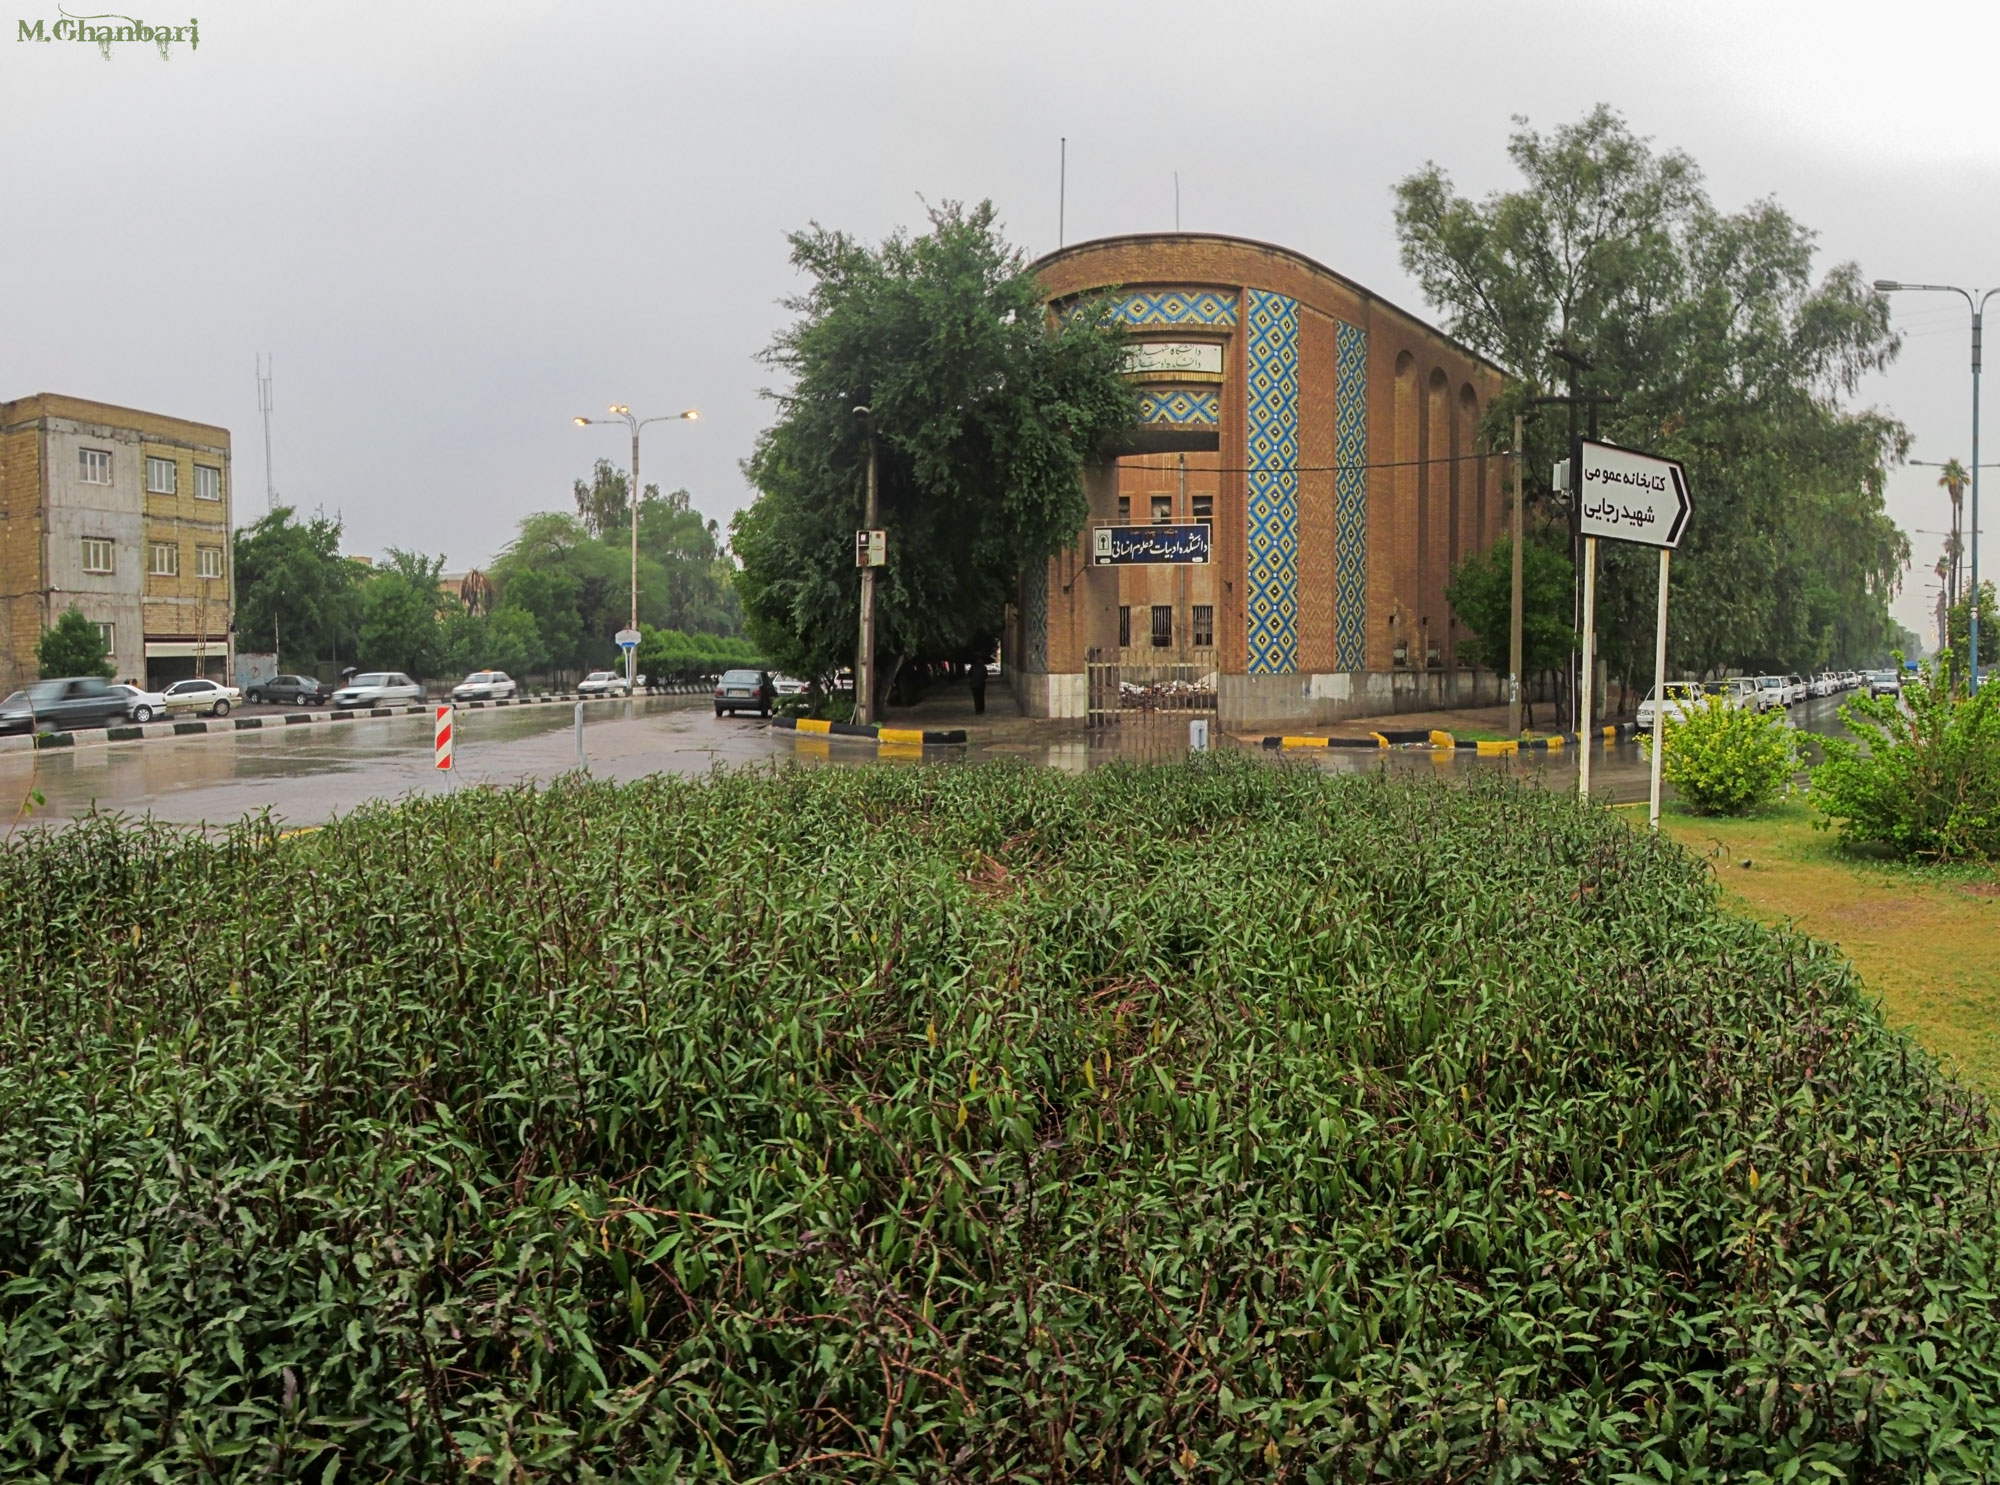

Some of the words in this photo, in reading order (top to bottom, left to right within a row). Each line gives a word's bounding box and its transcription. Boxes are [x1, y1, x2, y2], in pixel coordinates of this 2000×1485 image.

[1170, 344, 1202, 356] دانشگاه
[1585, 468, 1622, 484] عمومی
[1623, 472, 1666, 494] کتابخانه
[1584, 497, 1619, 524] رجایی
[1621, 505, 1655, 527] شهید
[1112, 540, 1134, 558] انسانی
[1132, 540, 1149, 560] علوم
[1149, 541, 1181, 559] ادبیات
[1179, 532, 1208, 554] دانشکده
